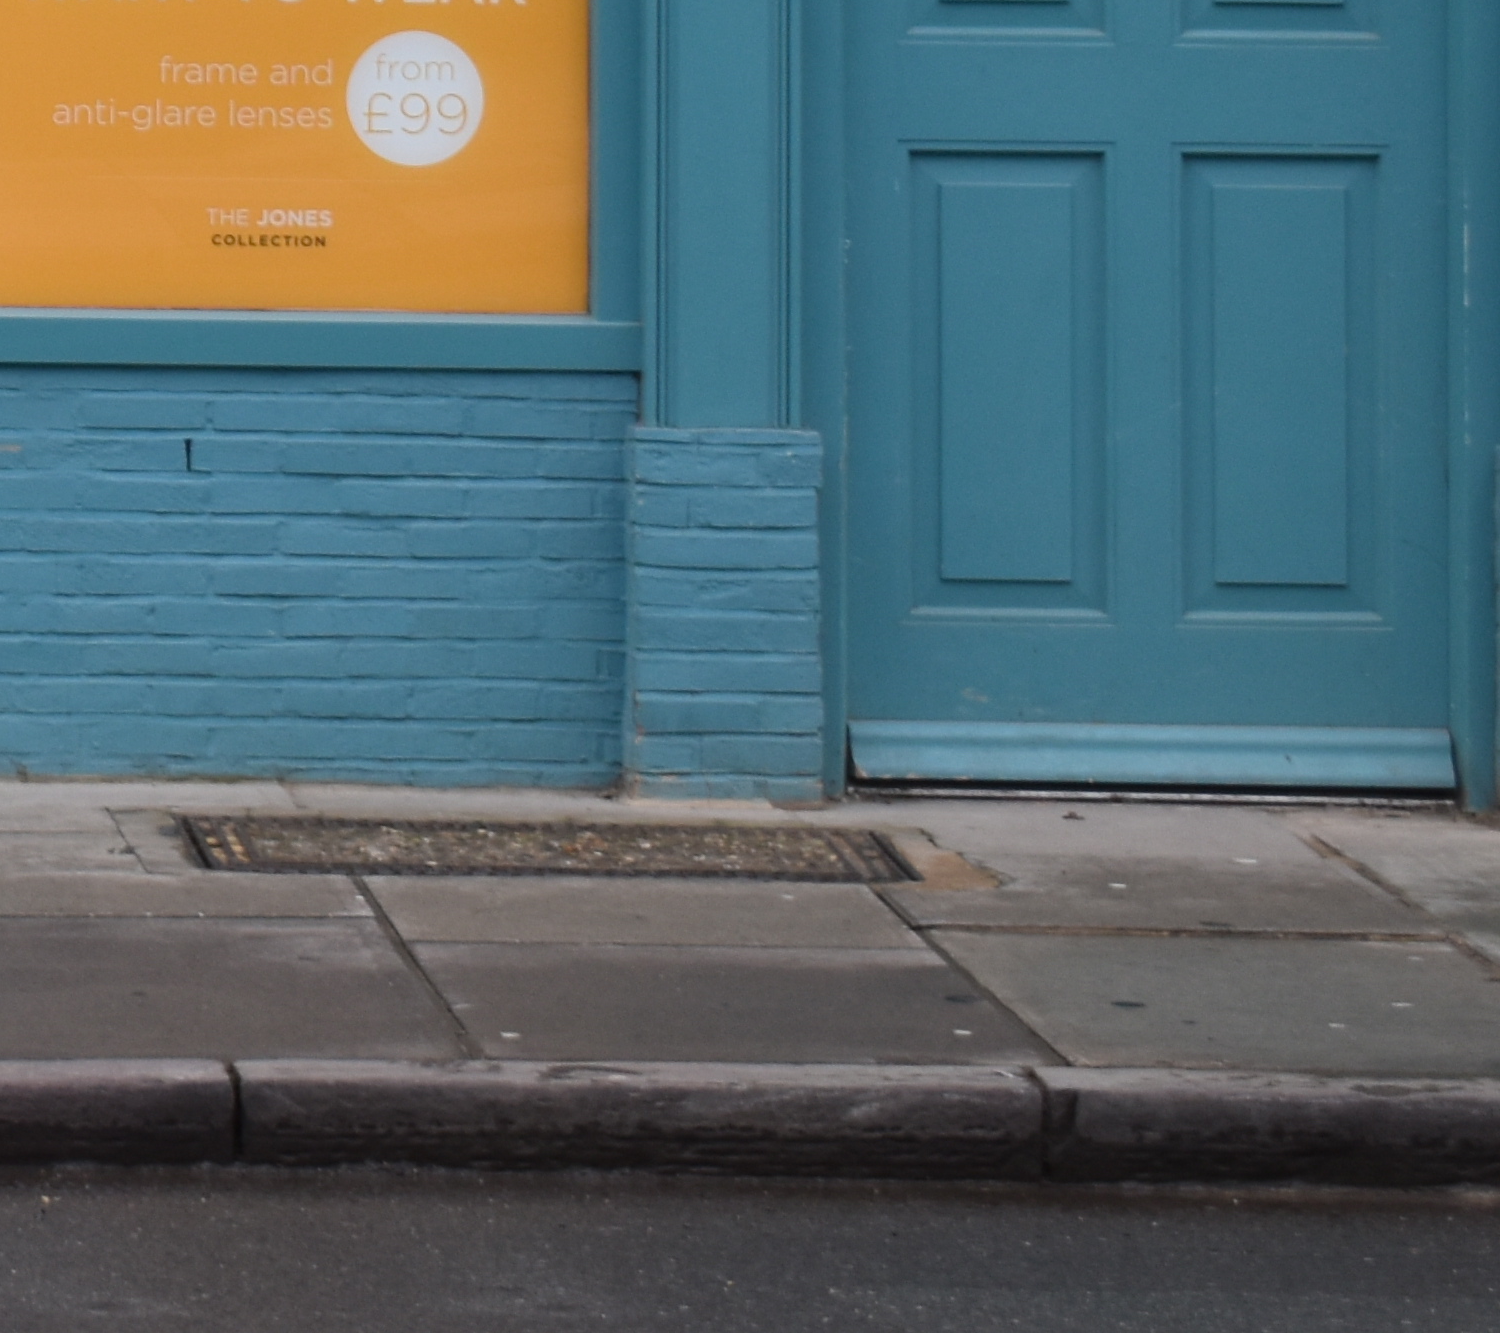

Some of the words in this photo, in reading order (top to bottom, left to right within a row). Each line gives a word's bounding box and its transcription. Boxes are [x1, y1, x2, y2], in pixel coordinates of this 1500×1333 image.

[159, 55, 258, 87] frame
[269, 58, 333, 87] and
[375, 53, 456, 82] from
[52, 98, 216, 132] anti-glare
[228, 100, 333, 129] lenses
[362, 91, 469, 136] £99
[207, 207, 250, 227] THE
[256, 208, 333, 228] JONES
[211, 233, 327, 248] COLLECTION
